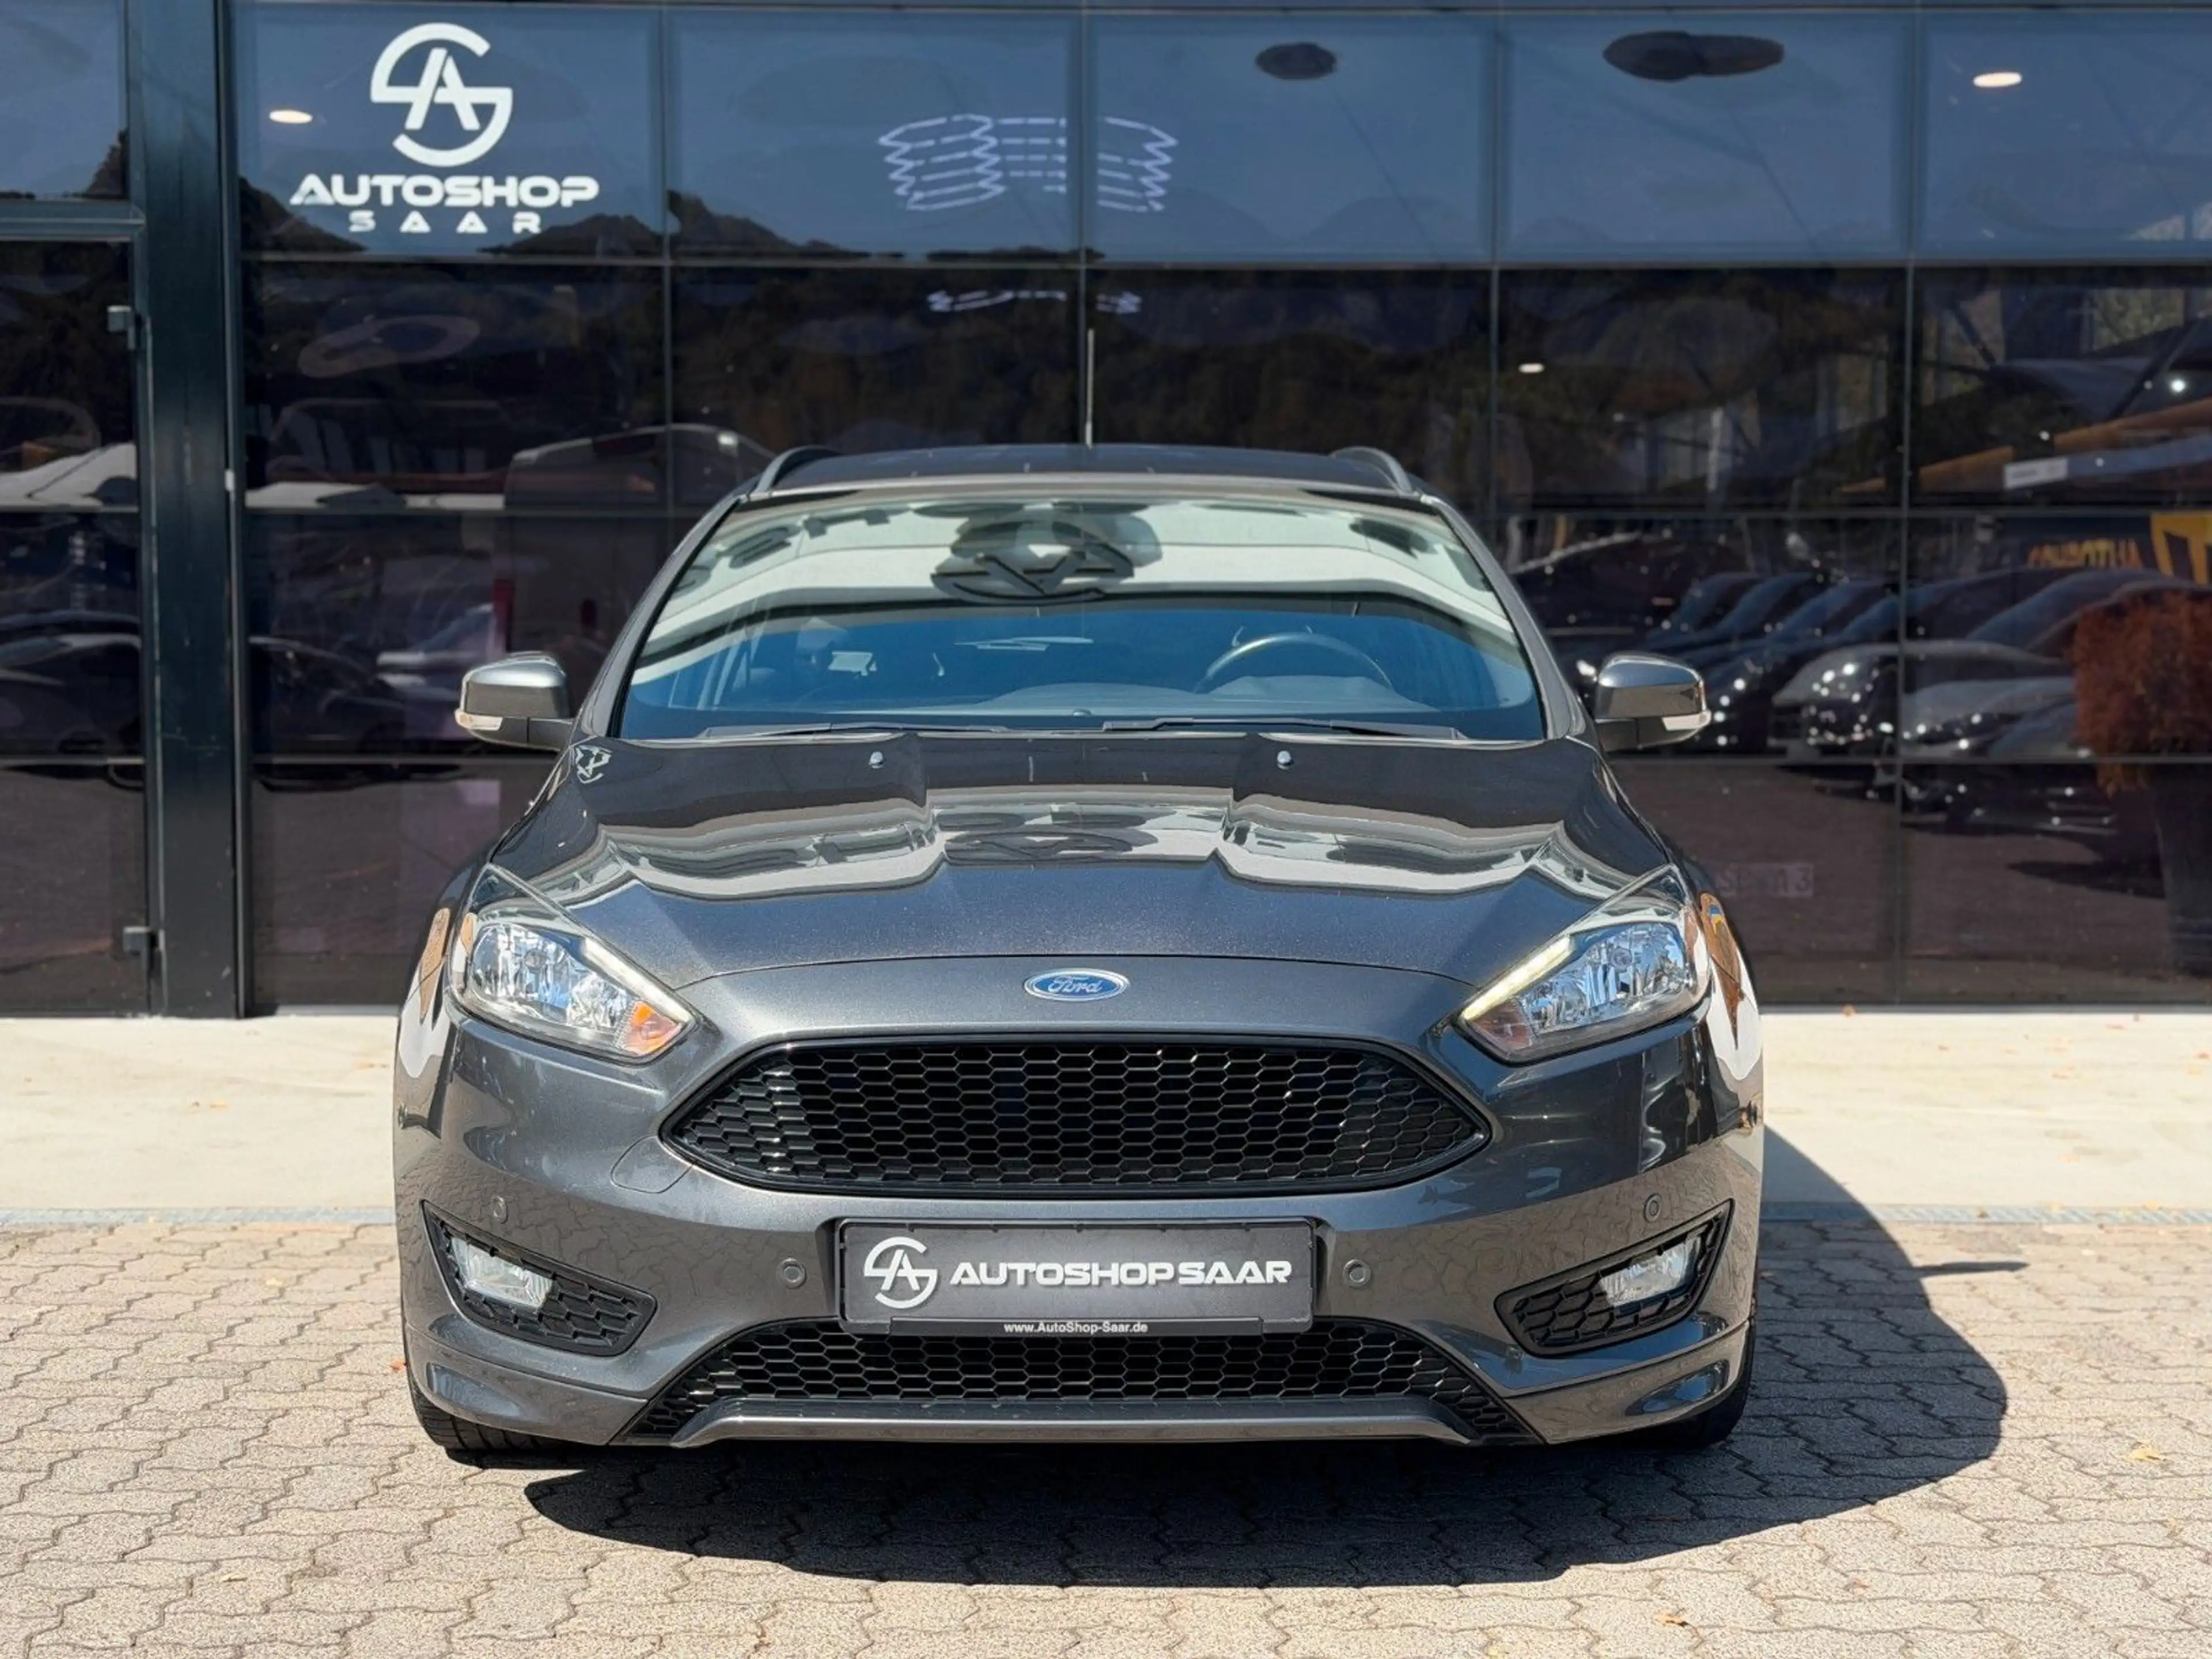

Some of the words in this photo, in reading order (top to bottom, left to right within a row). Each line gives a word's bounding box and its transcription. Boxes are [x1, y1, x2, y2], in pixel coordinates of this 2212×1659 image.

[289, 173, 600, 208] AUTOSHOP
[349, 210, 541, 234] SAAR
[1047, 976, 1103, 992] Ford
[1003, 1321, 1148, 1335] www.AutoShop-Saar.de
